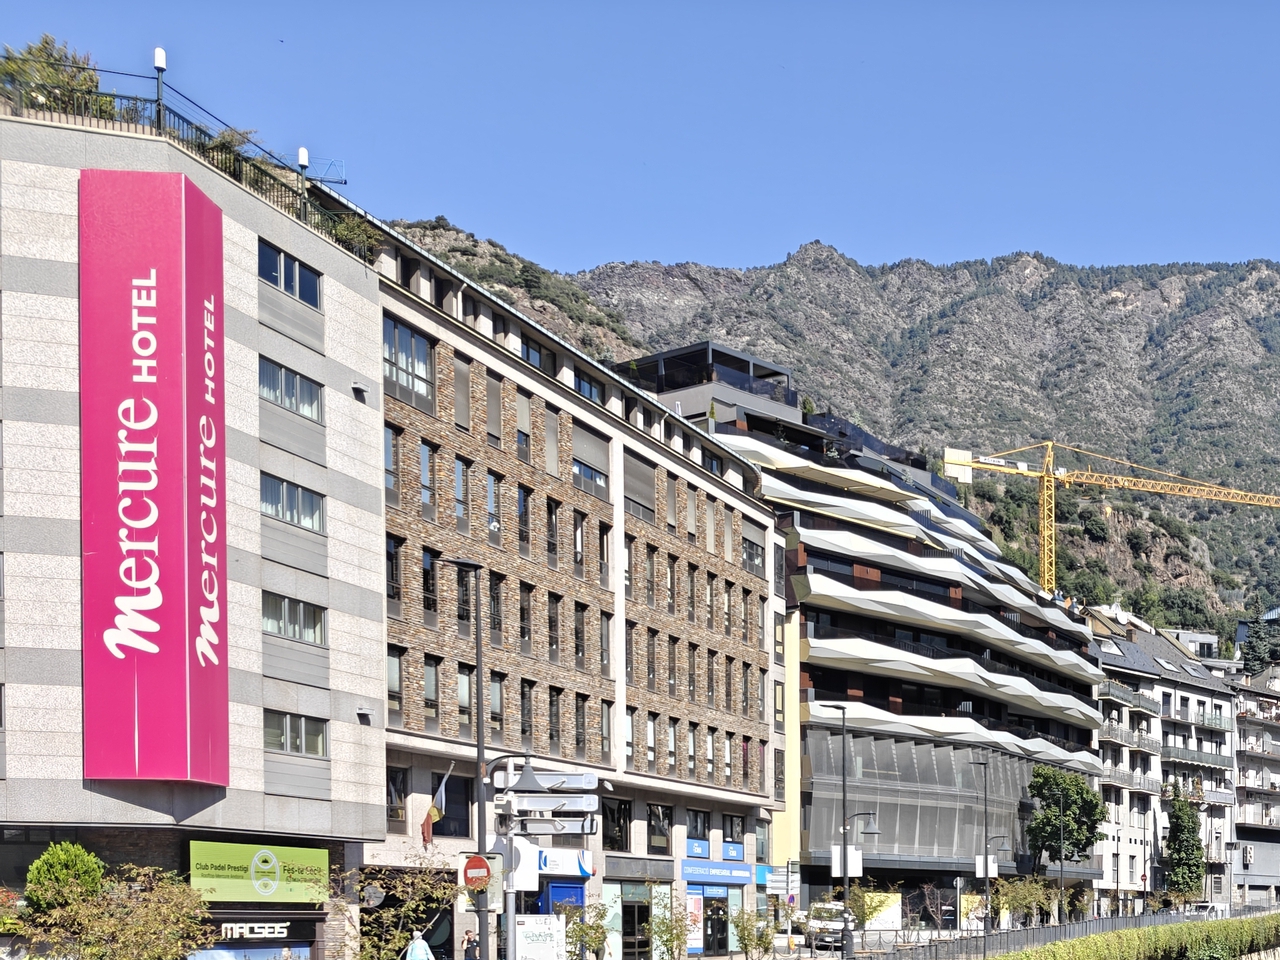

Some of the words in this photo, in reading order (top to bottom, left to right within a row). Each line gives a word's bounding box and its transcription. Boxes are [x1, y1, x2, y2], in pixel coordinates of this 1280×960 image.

[203, 294, 216, 405] HOTEL
[103, 397, 163, 659] Mercure
[133, 268, 158, 383] HOTEL
[195, 414, 220, 667] Mercure
[195, 862, 209, 871] Club
[210, 863, 226, 871] Padel
[227, 864, 249, 873] Prestigi
